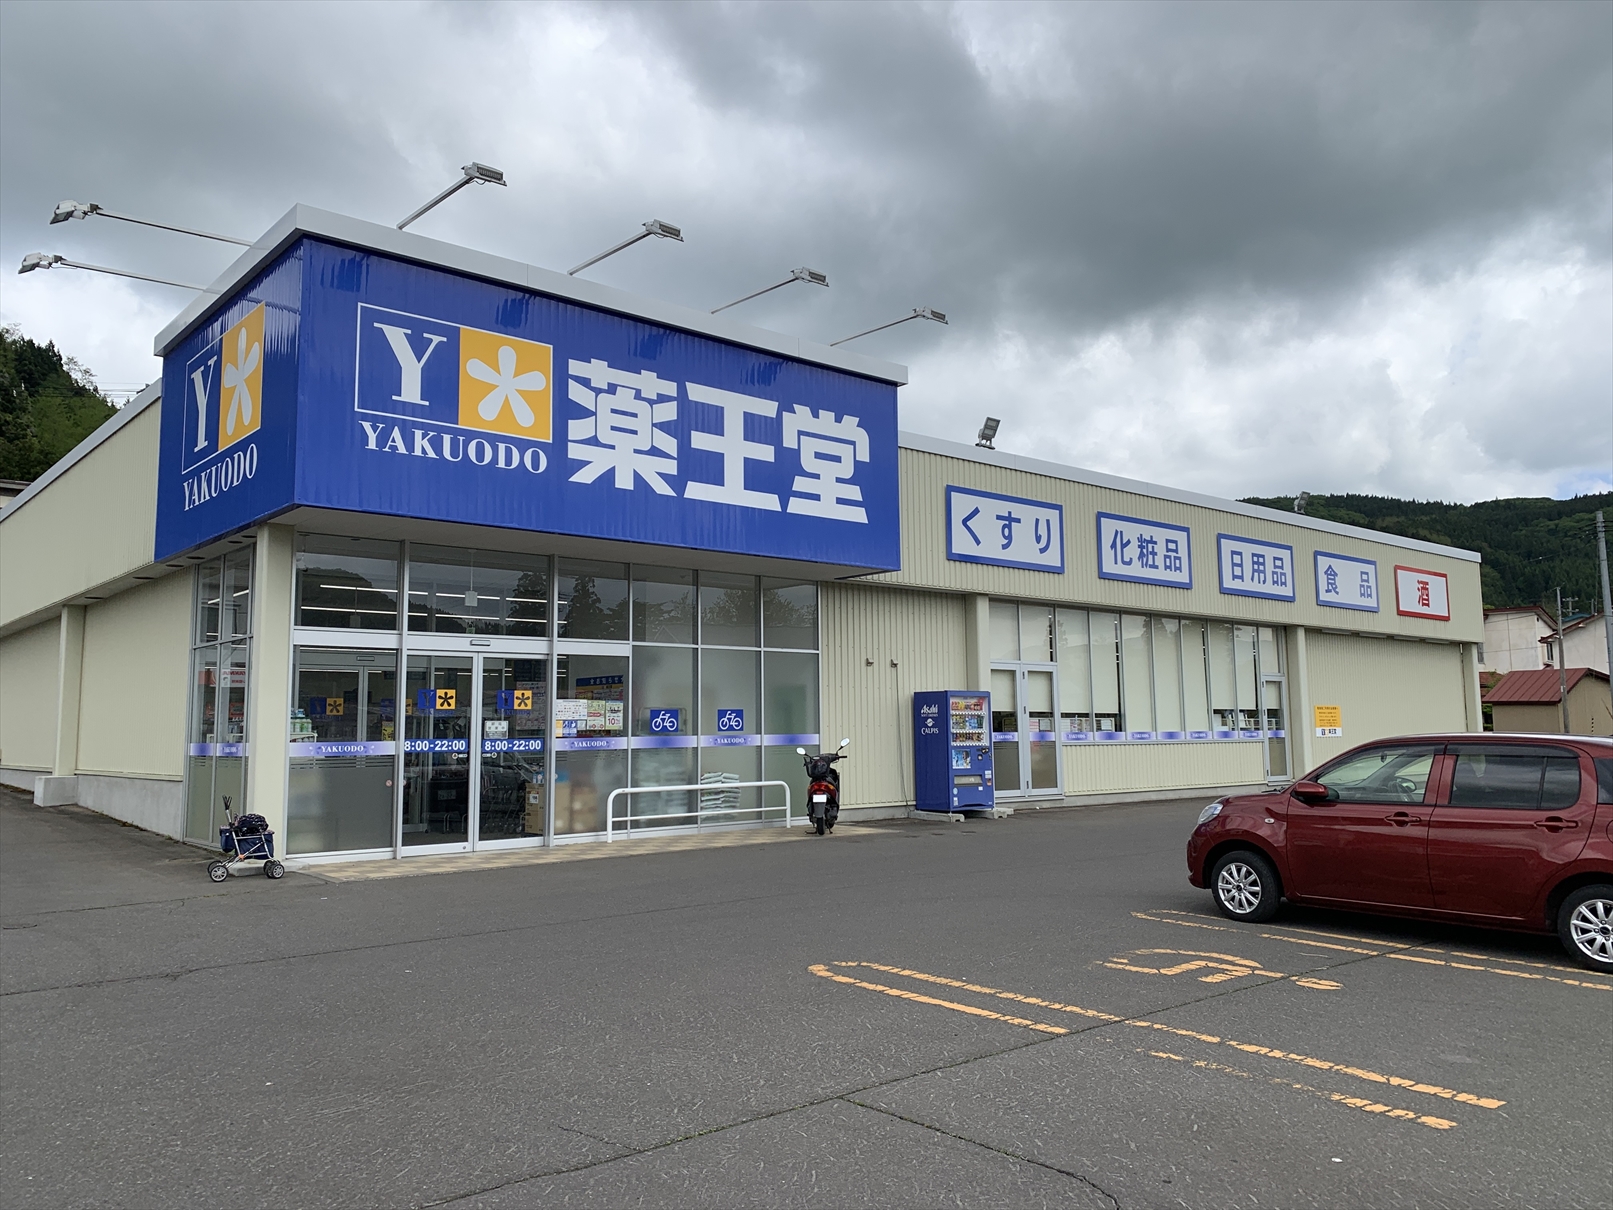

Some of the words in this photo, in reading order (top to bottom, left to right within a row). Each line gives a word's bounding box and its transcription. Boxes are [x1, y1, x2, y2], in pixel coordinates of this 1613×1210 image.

[373, 322, 447, 406] Y
[191, 355, 217, 453] Y
[358, 420, 548, 474] YAKUODO
[568, 358, 870, 524] 薬王堂
[183, 443, 258, 511] YAKUODO
[961, 506, 1052, 554] くすり
[1110, 529, 1183, 573] 化粧品
[1230, 550, 1288, 588] 日用品
[1324, 564, 1373, 599] 食品
[1417, 579, 1431, 608] 酒
[921, 704, 938, 713] Asahi
[321, 744, 364, 753] YAKUODO
[404, 740, 466, 751] 8:00-22:00
[484, 740, 542, 751] 8:00-22:00
[921, 727, 939, 735] CALPIS
